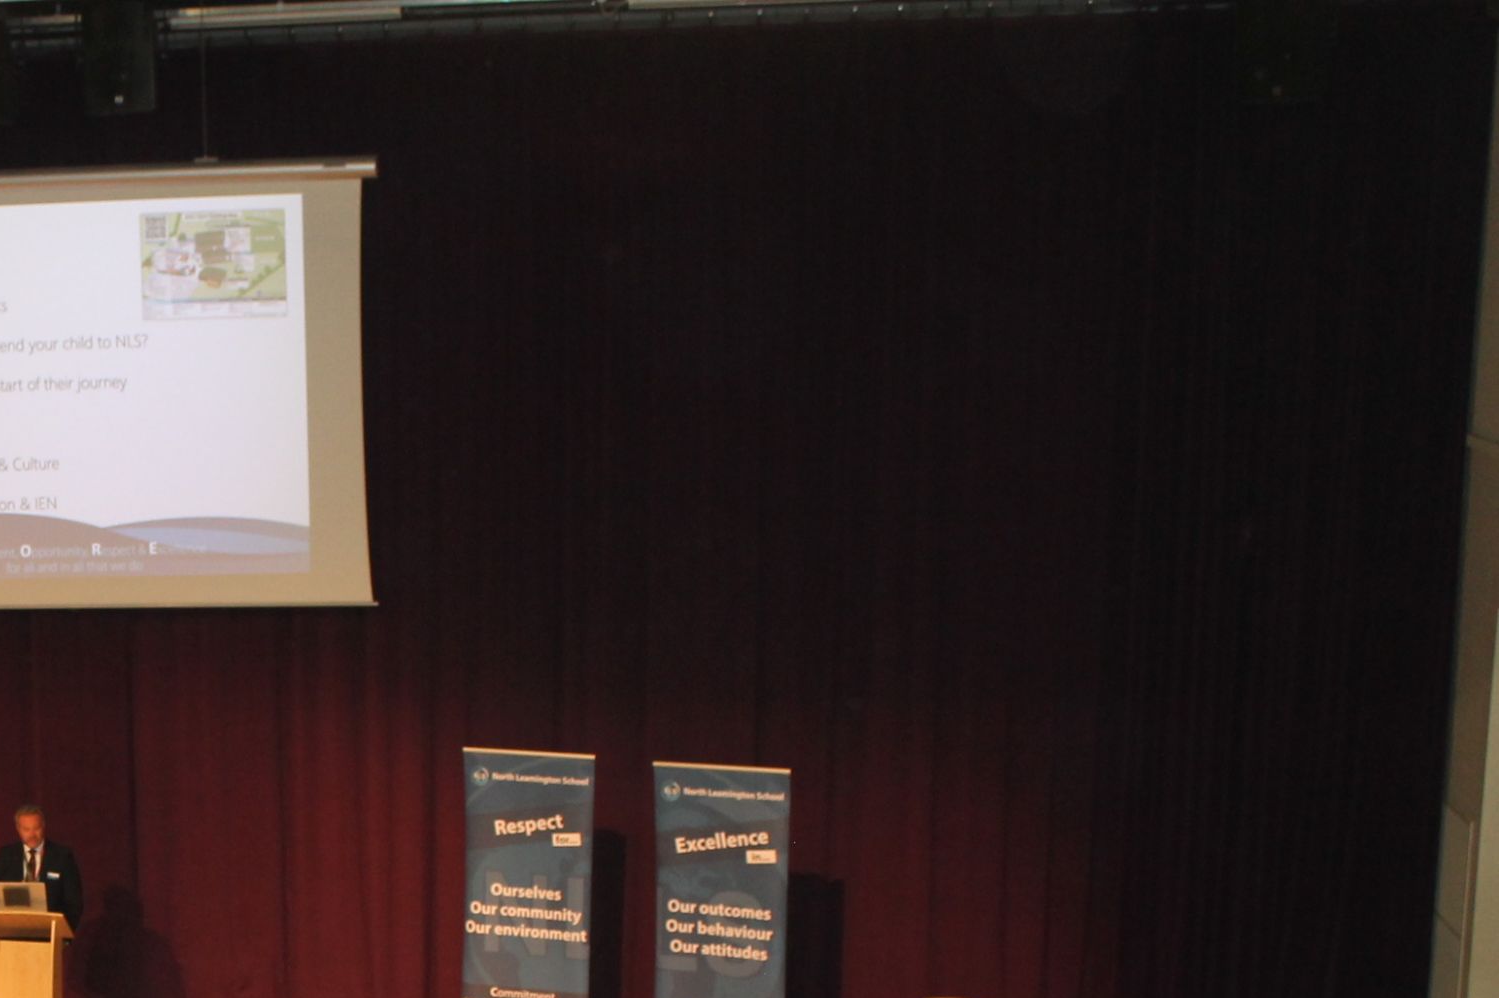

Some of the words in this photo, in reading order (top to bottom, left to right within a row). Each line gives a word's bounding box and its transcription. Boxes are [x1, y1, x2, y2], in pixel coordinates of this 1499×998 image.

[28, 338, 58, 355] your
[62, 335, 93, 350] child
[97, 336, 111, 349] to
[115, 334, 148, 348] NLS?
[27, 377, 40, 391] of
[44, 374, 73, 390] their
[76, 376, 127, 393] journey
[12, 457, 59, 471] Culture
[20, 497, 30, 510] &
[492, 772, 514, 781] North
[516, 774, 562, 785] Leamington
[562, 777, 589, 786] School
[683, 787, 707, 796] North
[708, 789, 756, 800] Leamington
[757, 792, 785, 802] School
[494, 814, 564, 836] Respect
[674, 831, 769, 853] Excellence
[491, 882, 562, 901] Ourselves
[470, 901, 497, 916] Our
[500, 905, 582, 925] community
[668, 898, 696, 913] Our
[699, 904, 772, 920] outcomes
[465, 920, 492, 935] Our
[494, 923, 587, 943] environment
[666, 918, 694, 933] Our
[697, 918, 773, 941] behaviour
[670, 939, 698, 954] Our
[701, 943, 768, 962] attitudes
